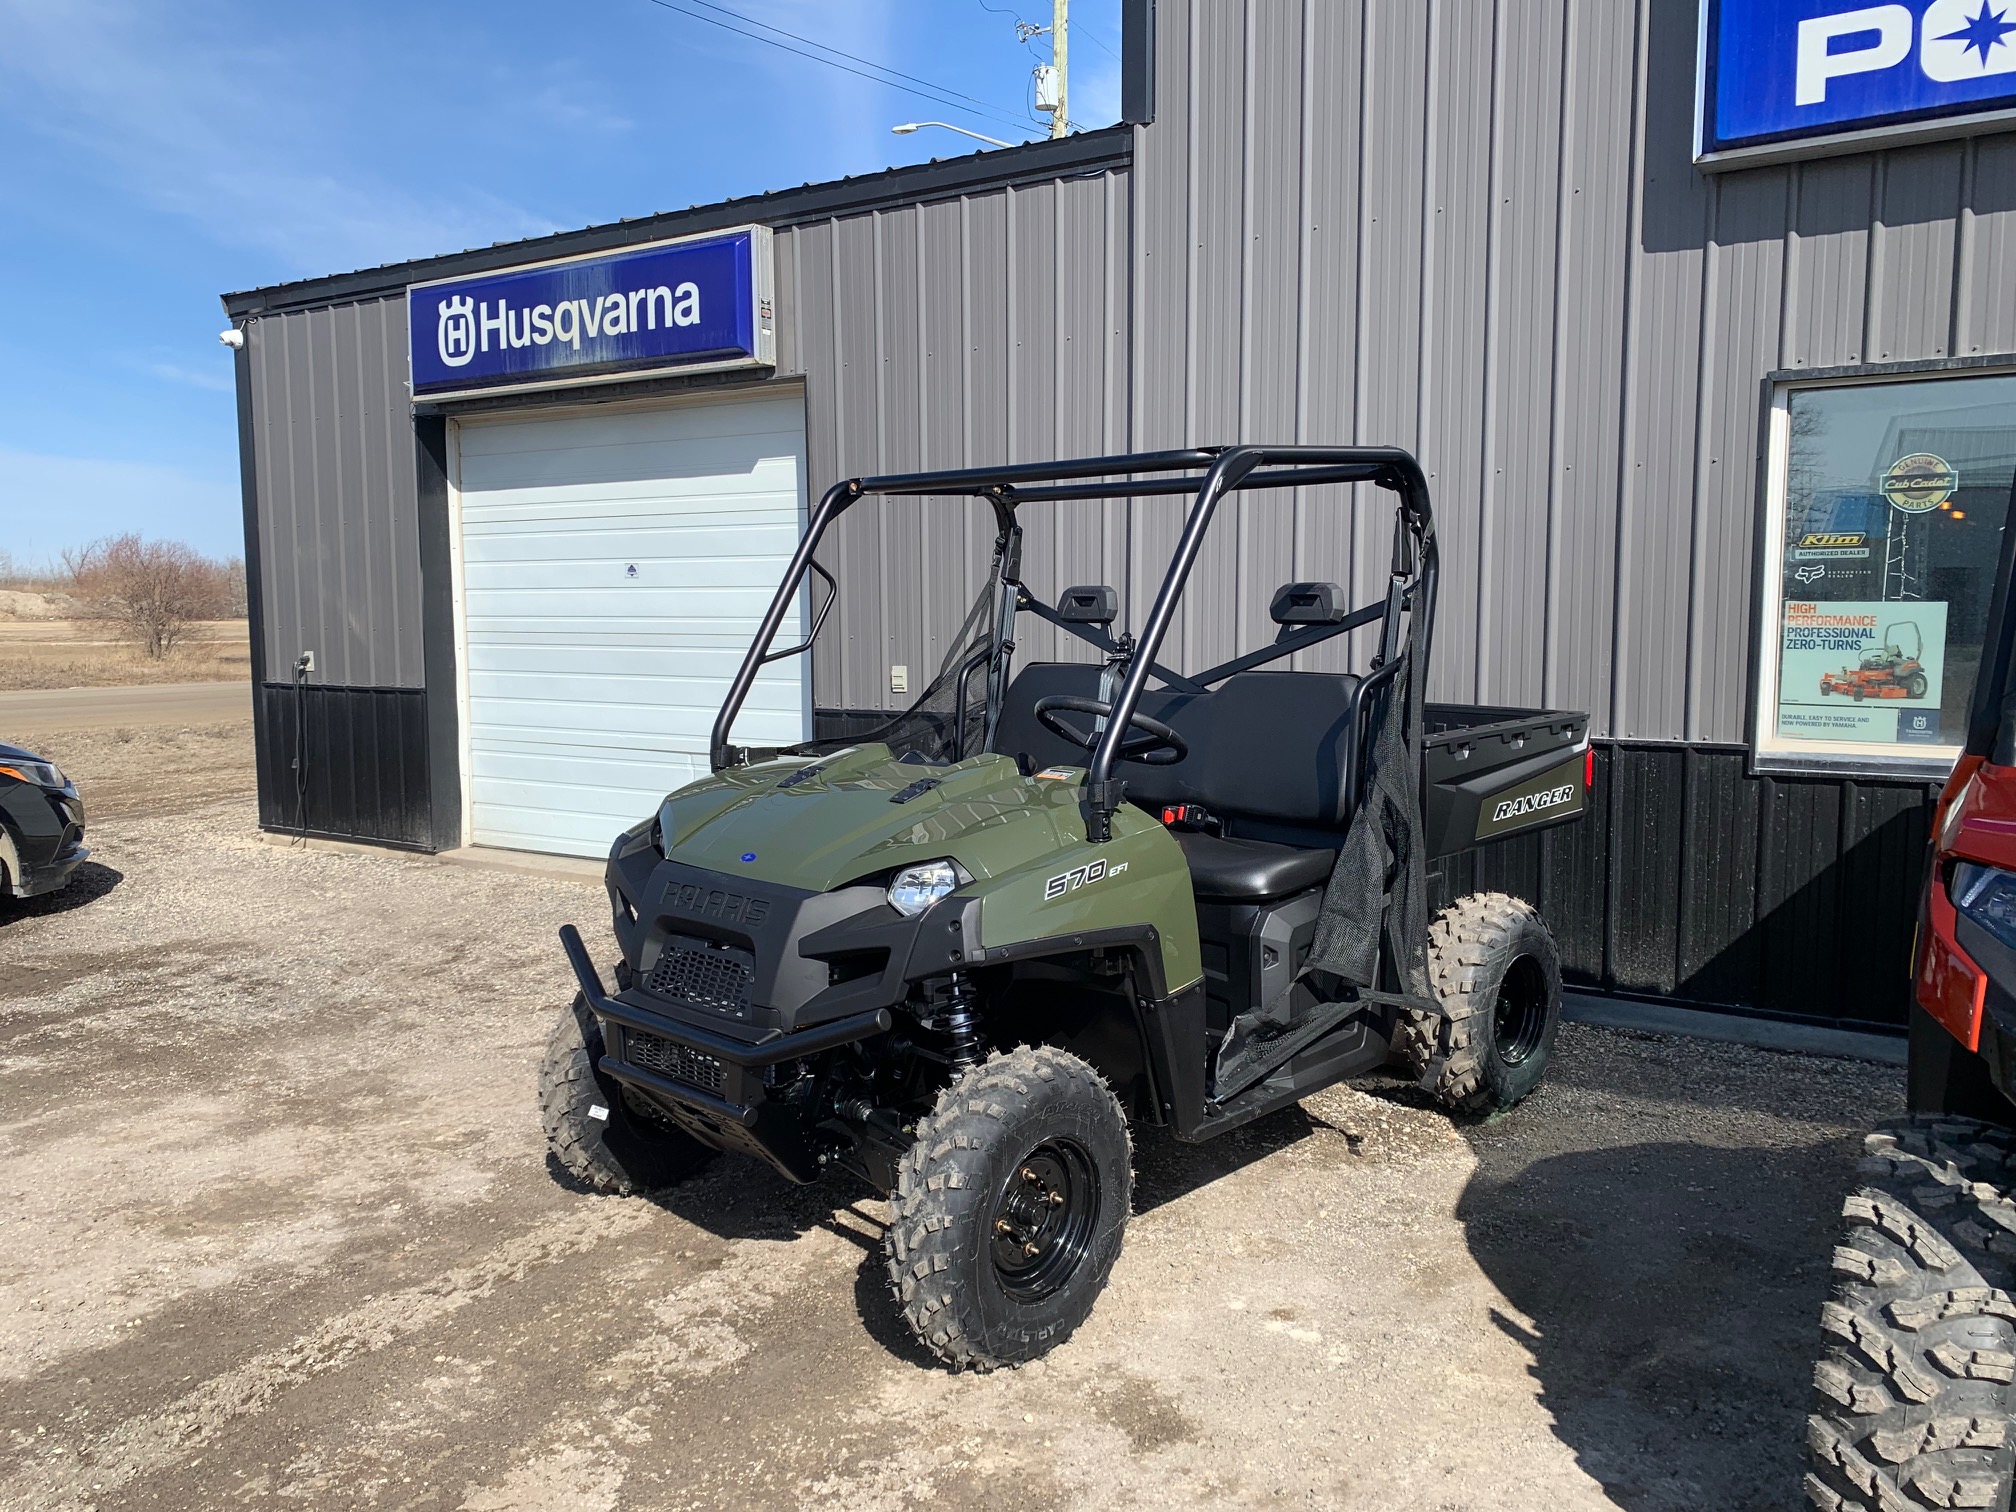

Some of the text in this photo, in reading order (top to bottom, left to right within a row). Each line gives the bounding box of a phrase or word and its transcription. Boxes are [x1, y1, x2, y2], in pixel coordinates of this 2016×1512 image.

[479, 281, 701, 351] Husqvarna
[1898, 458, 1940, 471] GENUINE
[1885, 477, 1953, 489] Cub Cadet
[1902, 498, 1934, 508] PARTS
[1788, 603, 1817, 614] HIGH
[1787, 615, 1877, 626] PERFORMANCE
[1786, 627, 1876, 639] PROFESSIONAL
[1786, 639, 1862, 651] ZERO-TURNS
[1493, 785, 1574, 821] RANGER
[1044, 858, 1129, 900] 570 EFI
[660, 880, 770, 926] POLARIS
